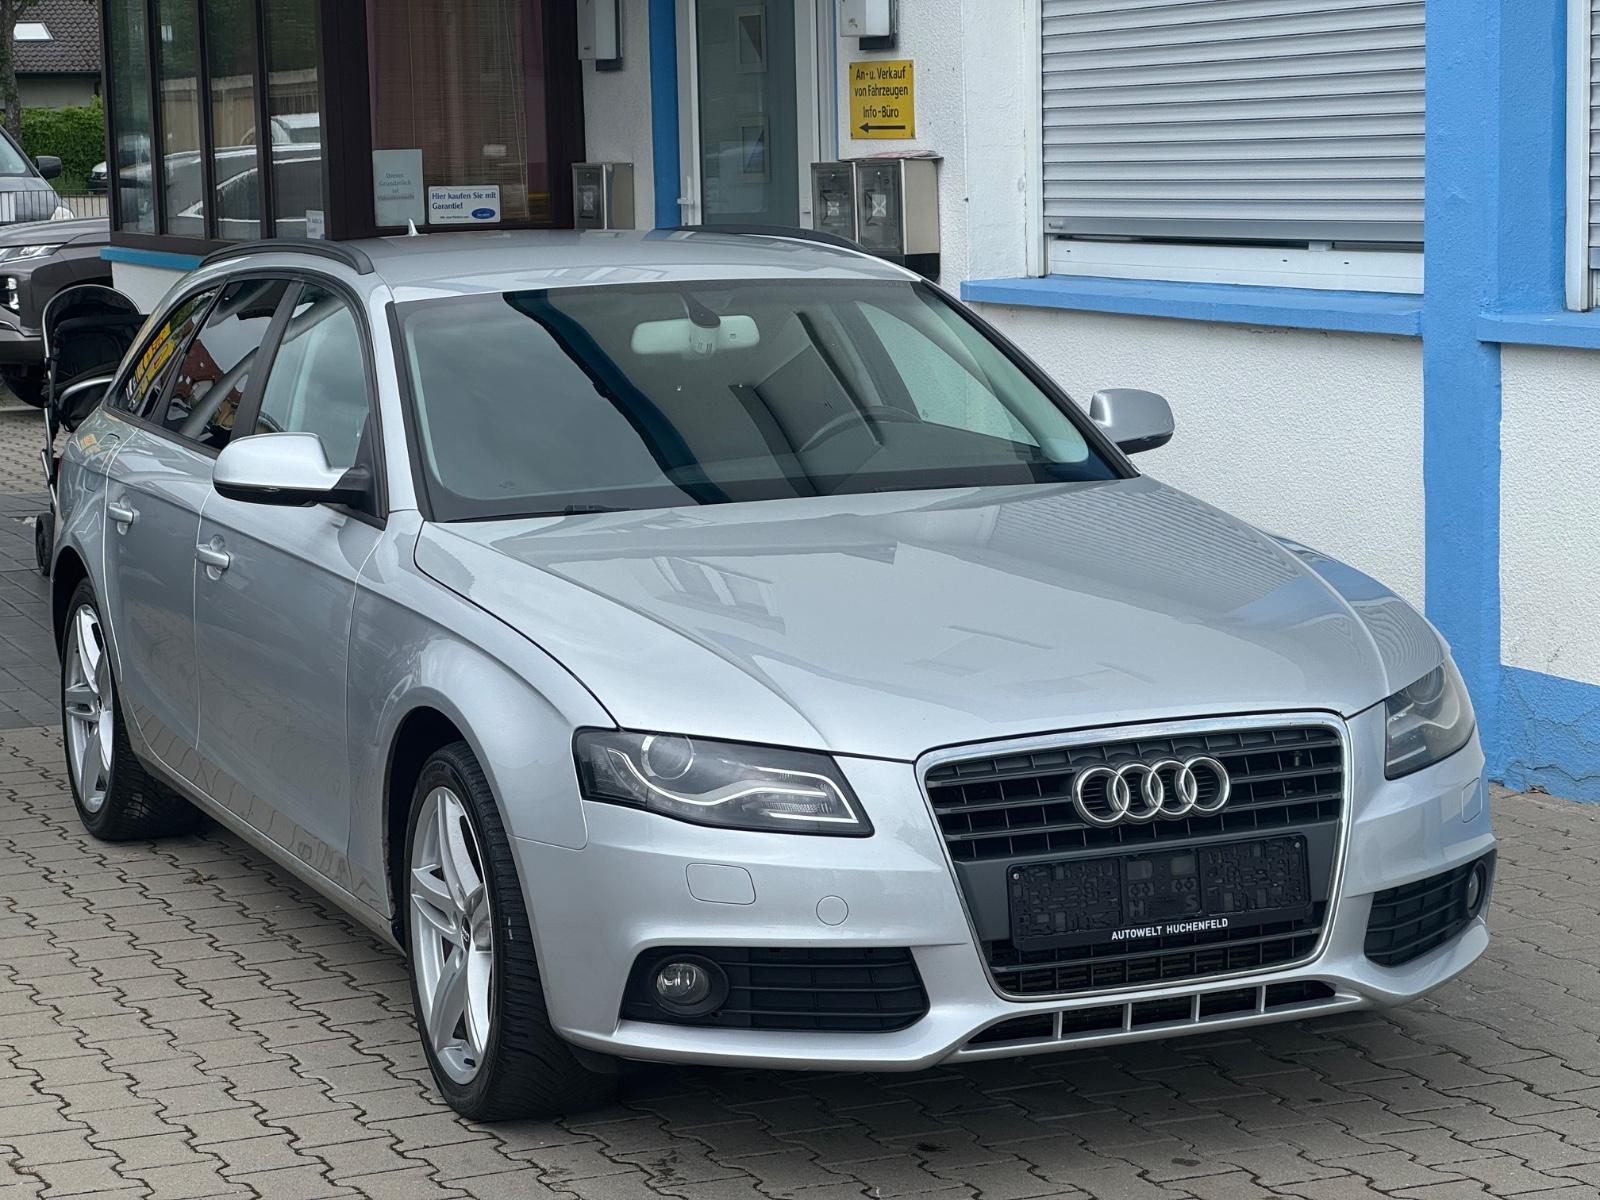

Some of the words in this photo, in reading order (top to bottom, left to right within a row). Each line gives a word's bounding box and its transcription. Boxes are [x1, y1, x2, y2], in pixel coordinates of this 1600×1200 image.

[876, 66, 906, 80] Verkauf
[854, 86, 867, 97] von
[867, 83, 909, 99] Fahrzeugen
[863, 105, 900, 118] Info-Büro
[432, 192, 446, 200] Hier
[448, 192, 471, 200] kaufen
[472, 191, 484, 200] Sie
[485, 191, 497, 199] mit
[432, 202, 463, 210] Garantie!
[1111, 926, 1163, 941] AUTOWELT
[1166, 918, 1229, 934] HUCHENFELD
